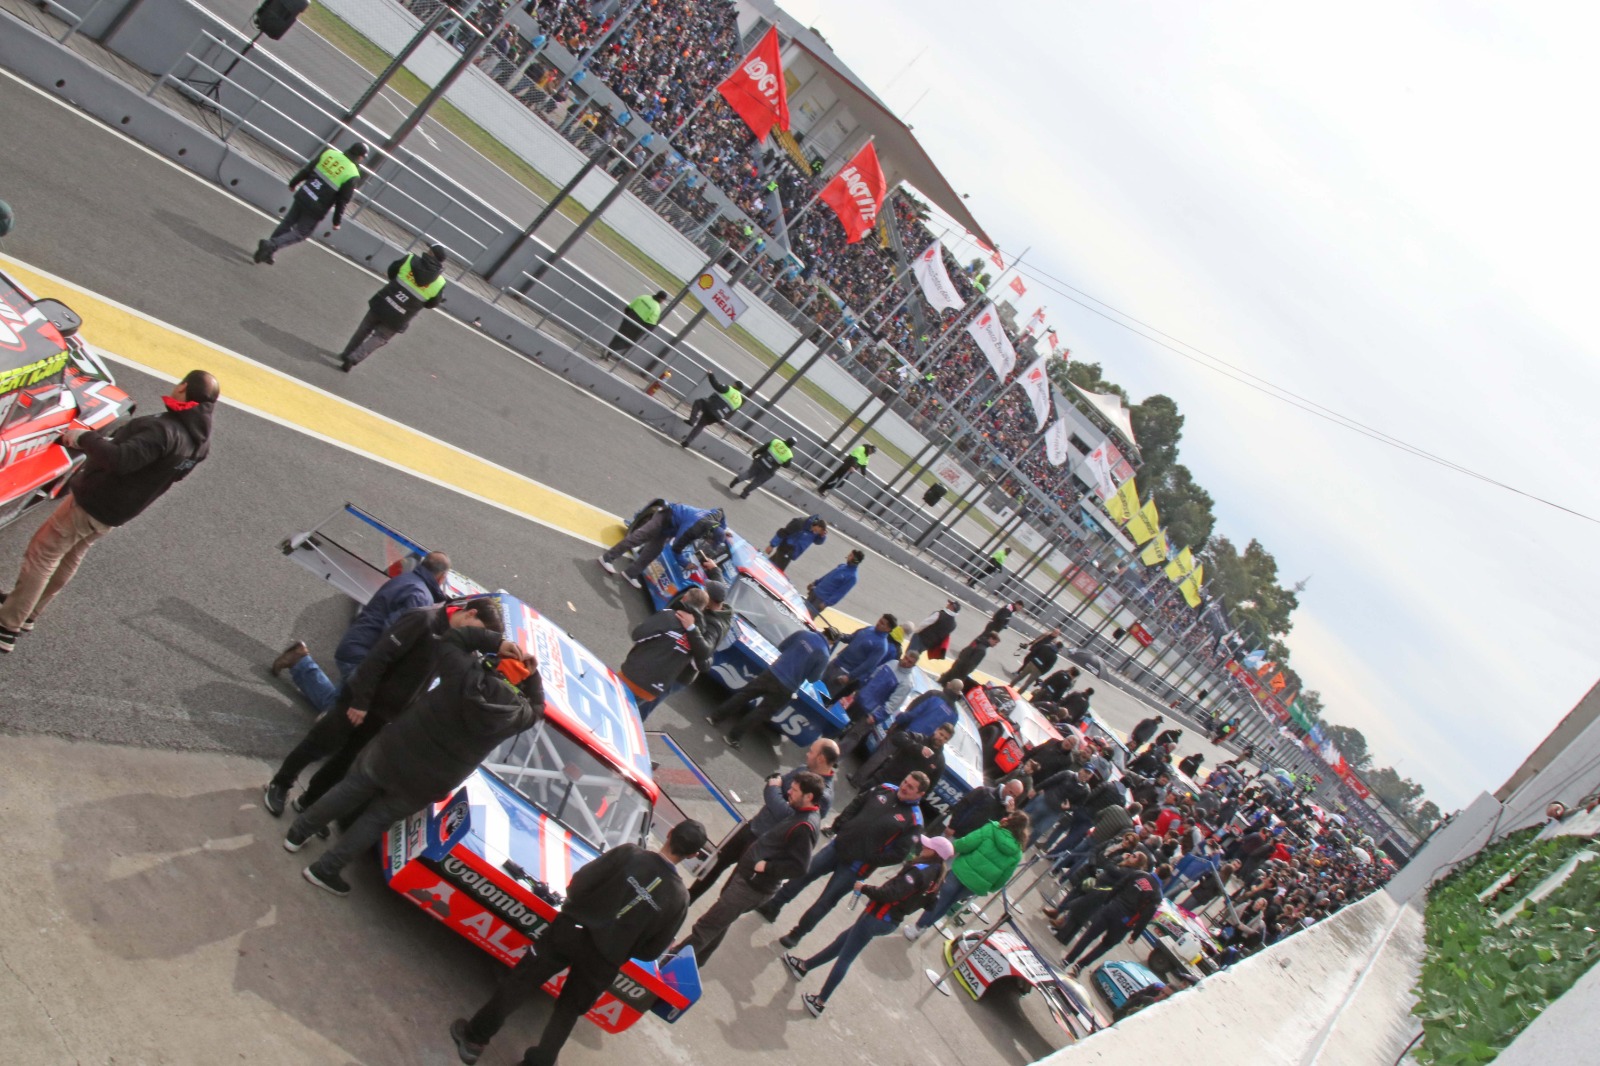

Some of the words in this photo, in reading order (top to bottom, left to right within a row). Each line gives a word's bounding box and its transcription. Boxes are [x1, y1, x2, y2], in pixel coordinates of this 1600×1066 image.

[321, 156, 345, 176] GPS
[839, 166, 876, 223] LOCTITE
[711, 292, 737, 320] HELIX
[717, 287, 731, 301] Shell
[443, 857, 538, 932] Colombo
